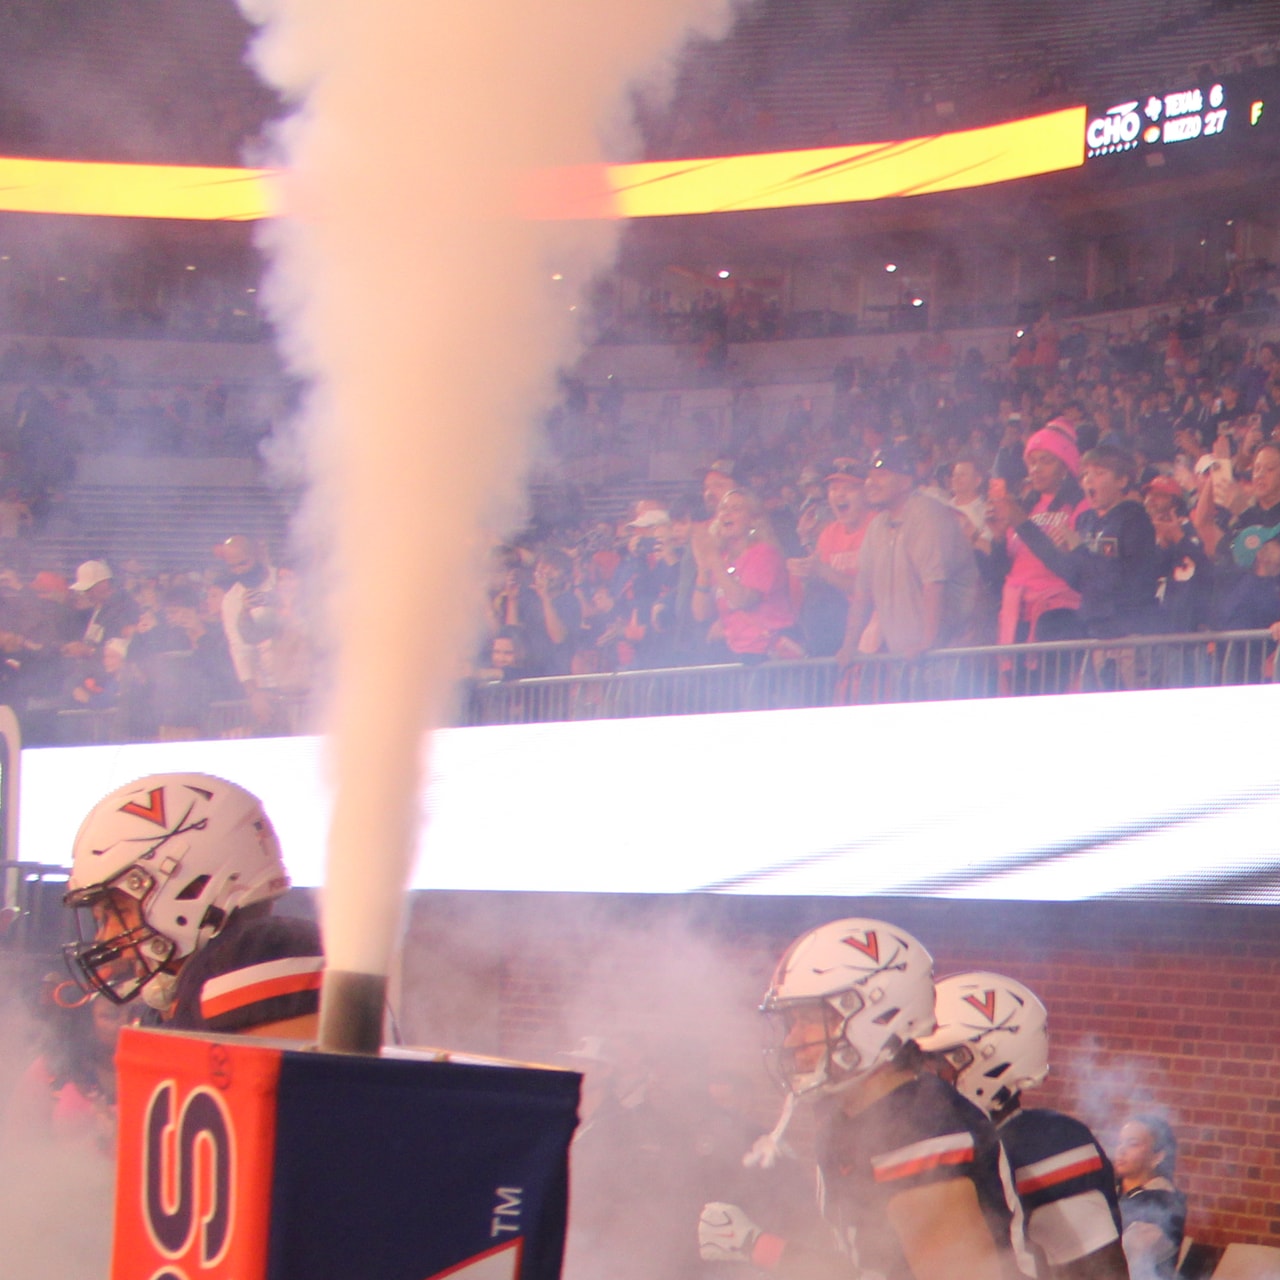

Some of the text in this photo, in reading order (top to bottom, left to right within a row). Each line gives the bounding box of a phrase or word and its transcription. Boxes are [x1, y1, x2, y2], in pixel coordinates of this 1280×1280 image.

[1203, 109, 1228, 136] 27
[1209, 84, 1224, 108] 6
[1250, 100, 1263, 125] F
[1086, 110, 1141, 149] CHO
